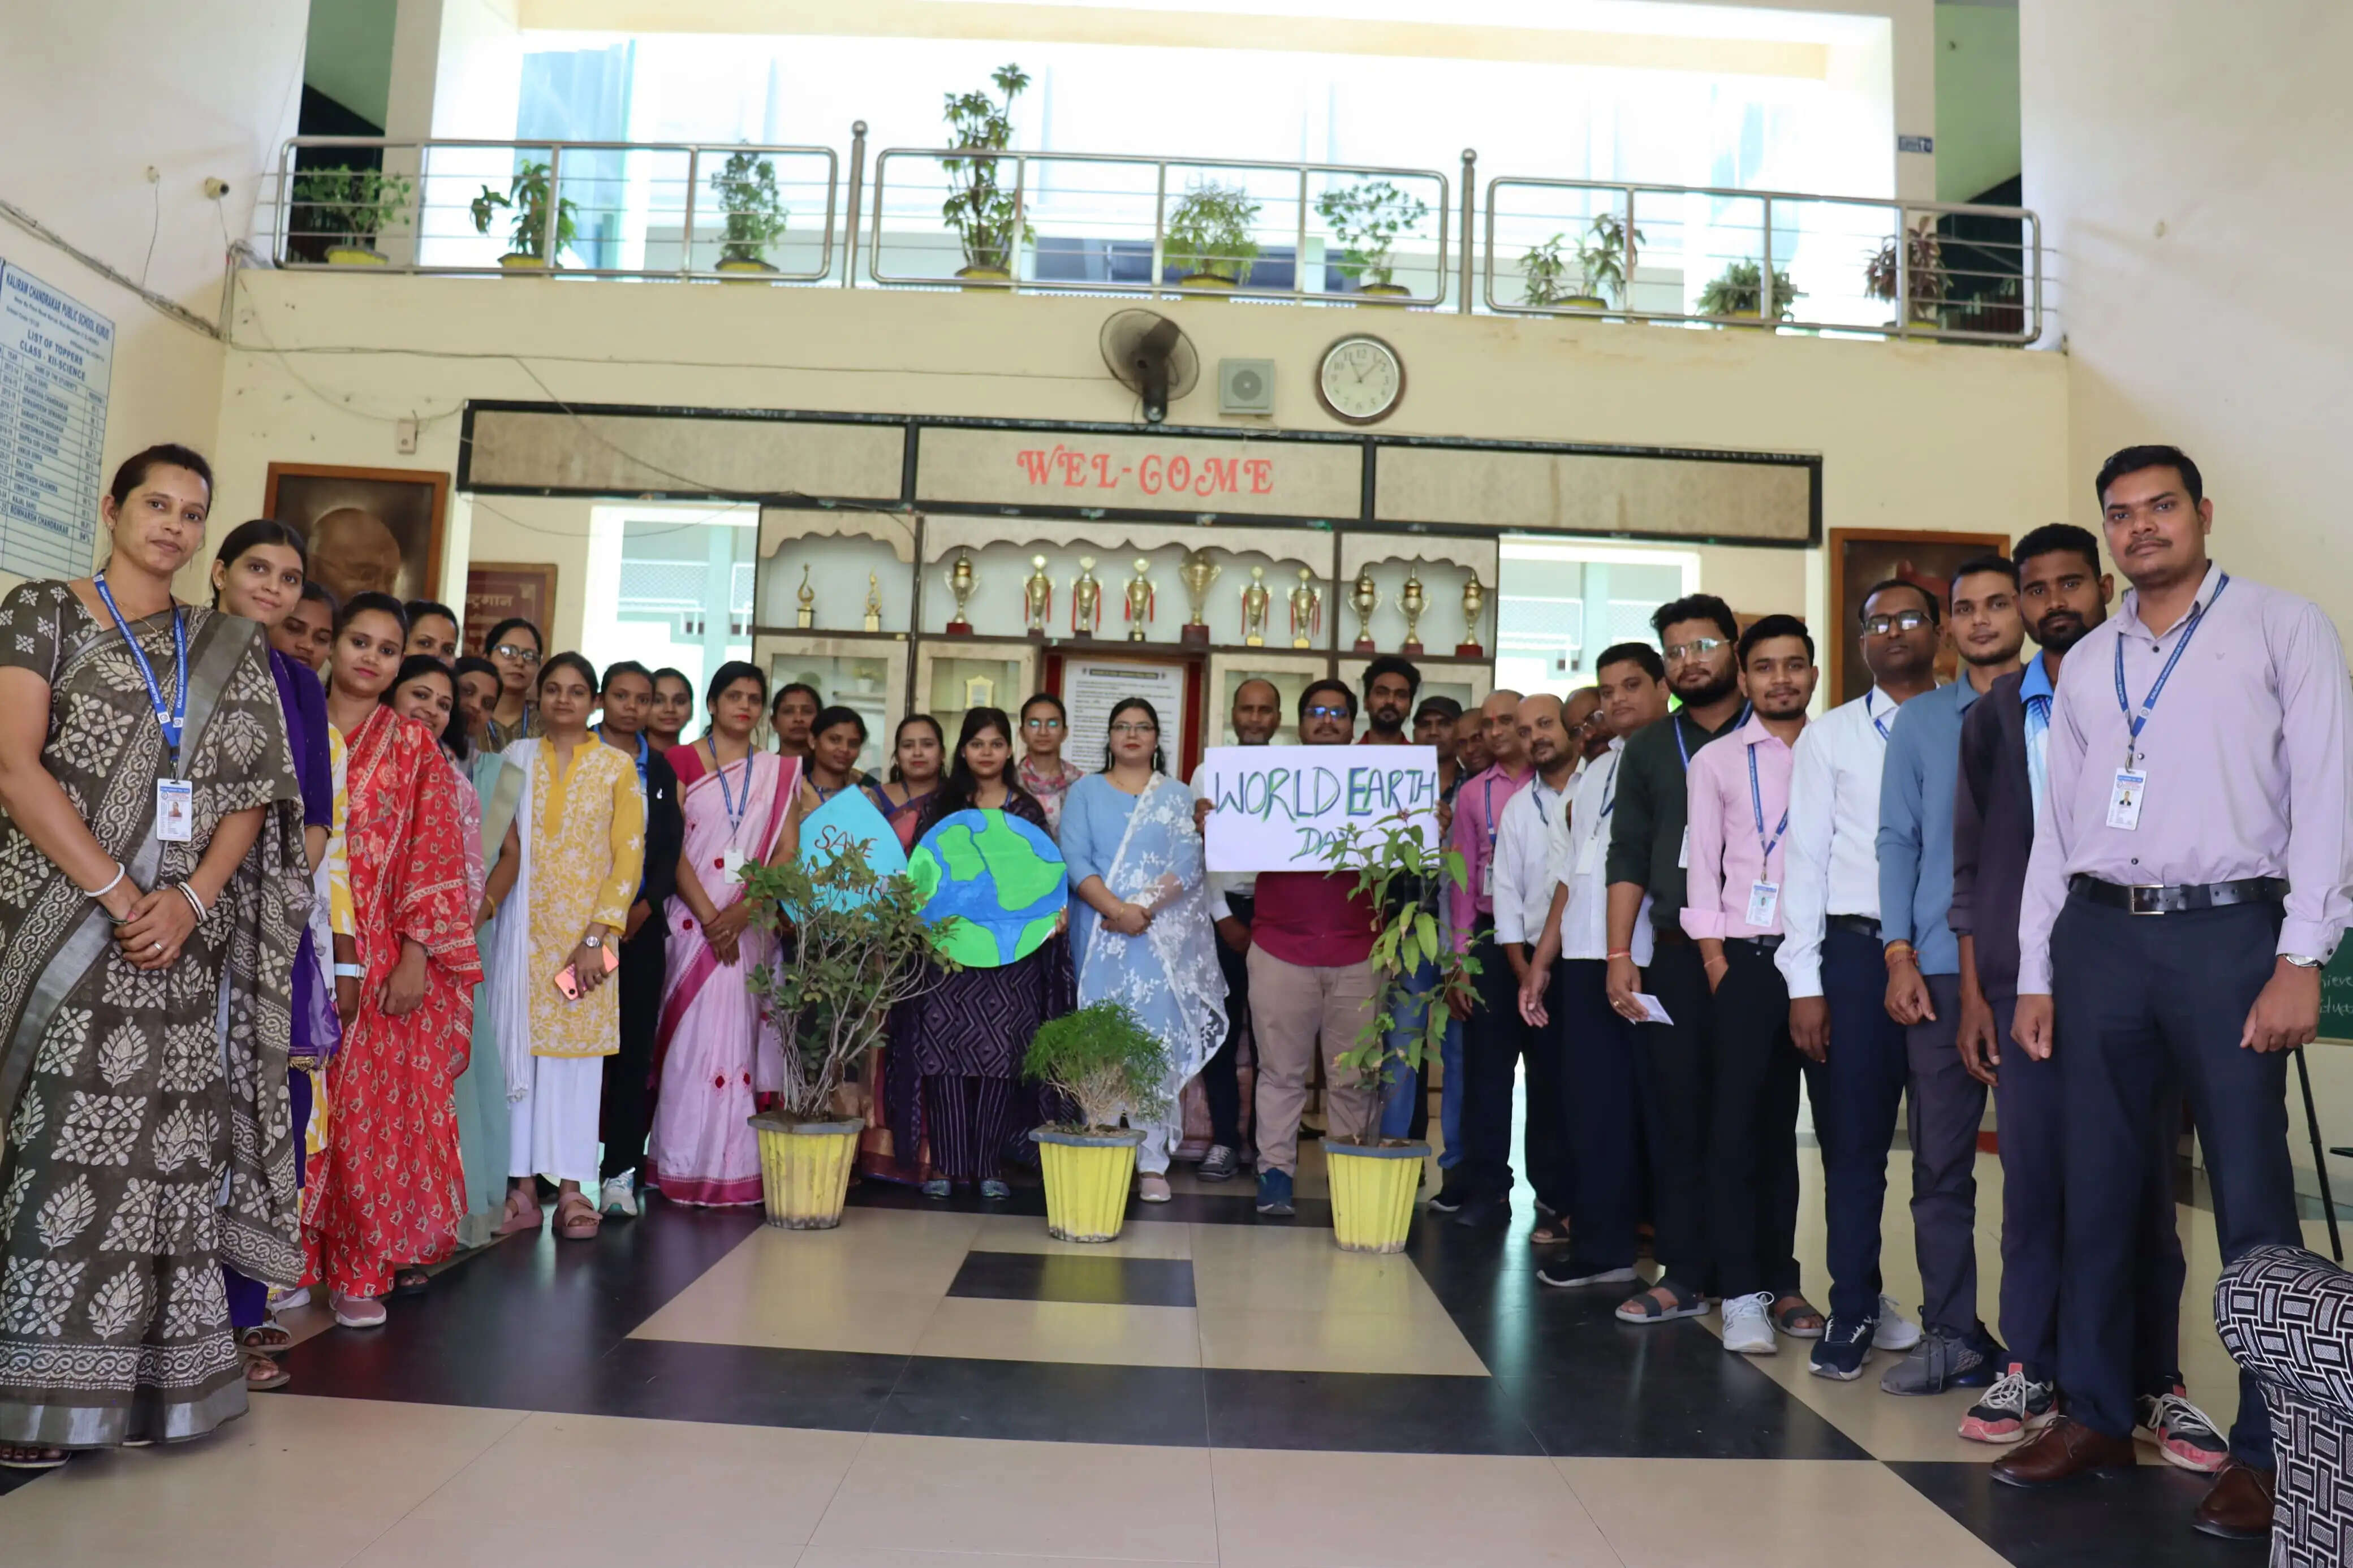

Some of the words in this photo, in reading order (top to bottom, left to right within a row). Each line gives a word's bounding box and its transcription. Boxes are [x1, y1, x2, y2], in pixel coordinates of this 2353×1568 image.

[6, 272, 28, 294] KALIRAM
[28, 285, 61, 312] CHANDRAKAR
[62, 304, 77, 321] PUBLIC
[77, 313, 94, 331] SCHOOL
[7, 351, 18, 360] YEAR
[19, 340, 41, 358] CLASS
[47, 355, 85, 381] XII-SCIENCE
[27, 330, 42, 344] LIST
[44, 338, 53, 349] OF
[54, 344, 83, 365] TOPPERS
[1358, 349, 1367, 358] 12
[37, 516, 68, 535] CHANDRAKAR
[1216, 767, 1341, 823] WORLD
[1346, 766, 1437, 818] EARTH
